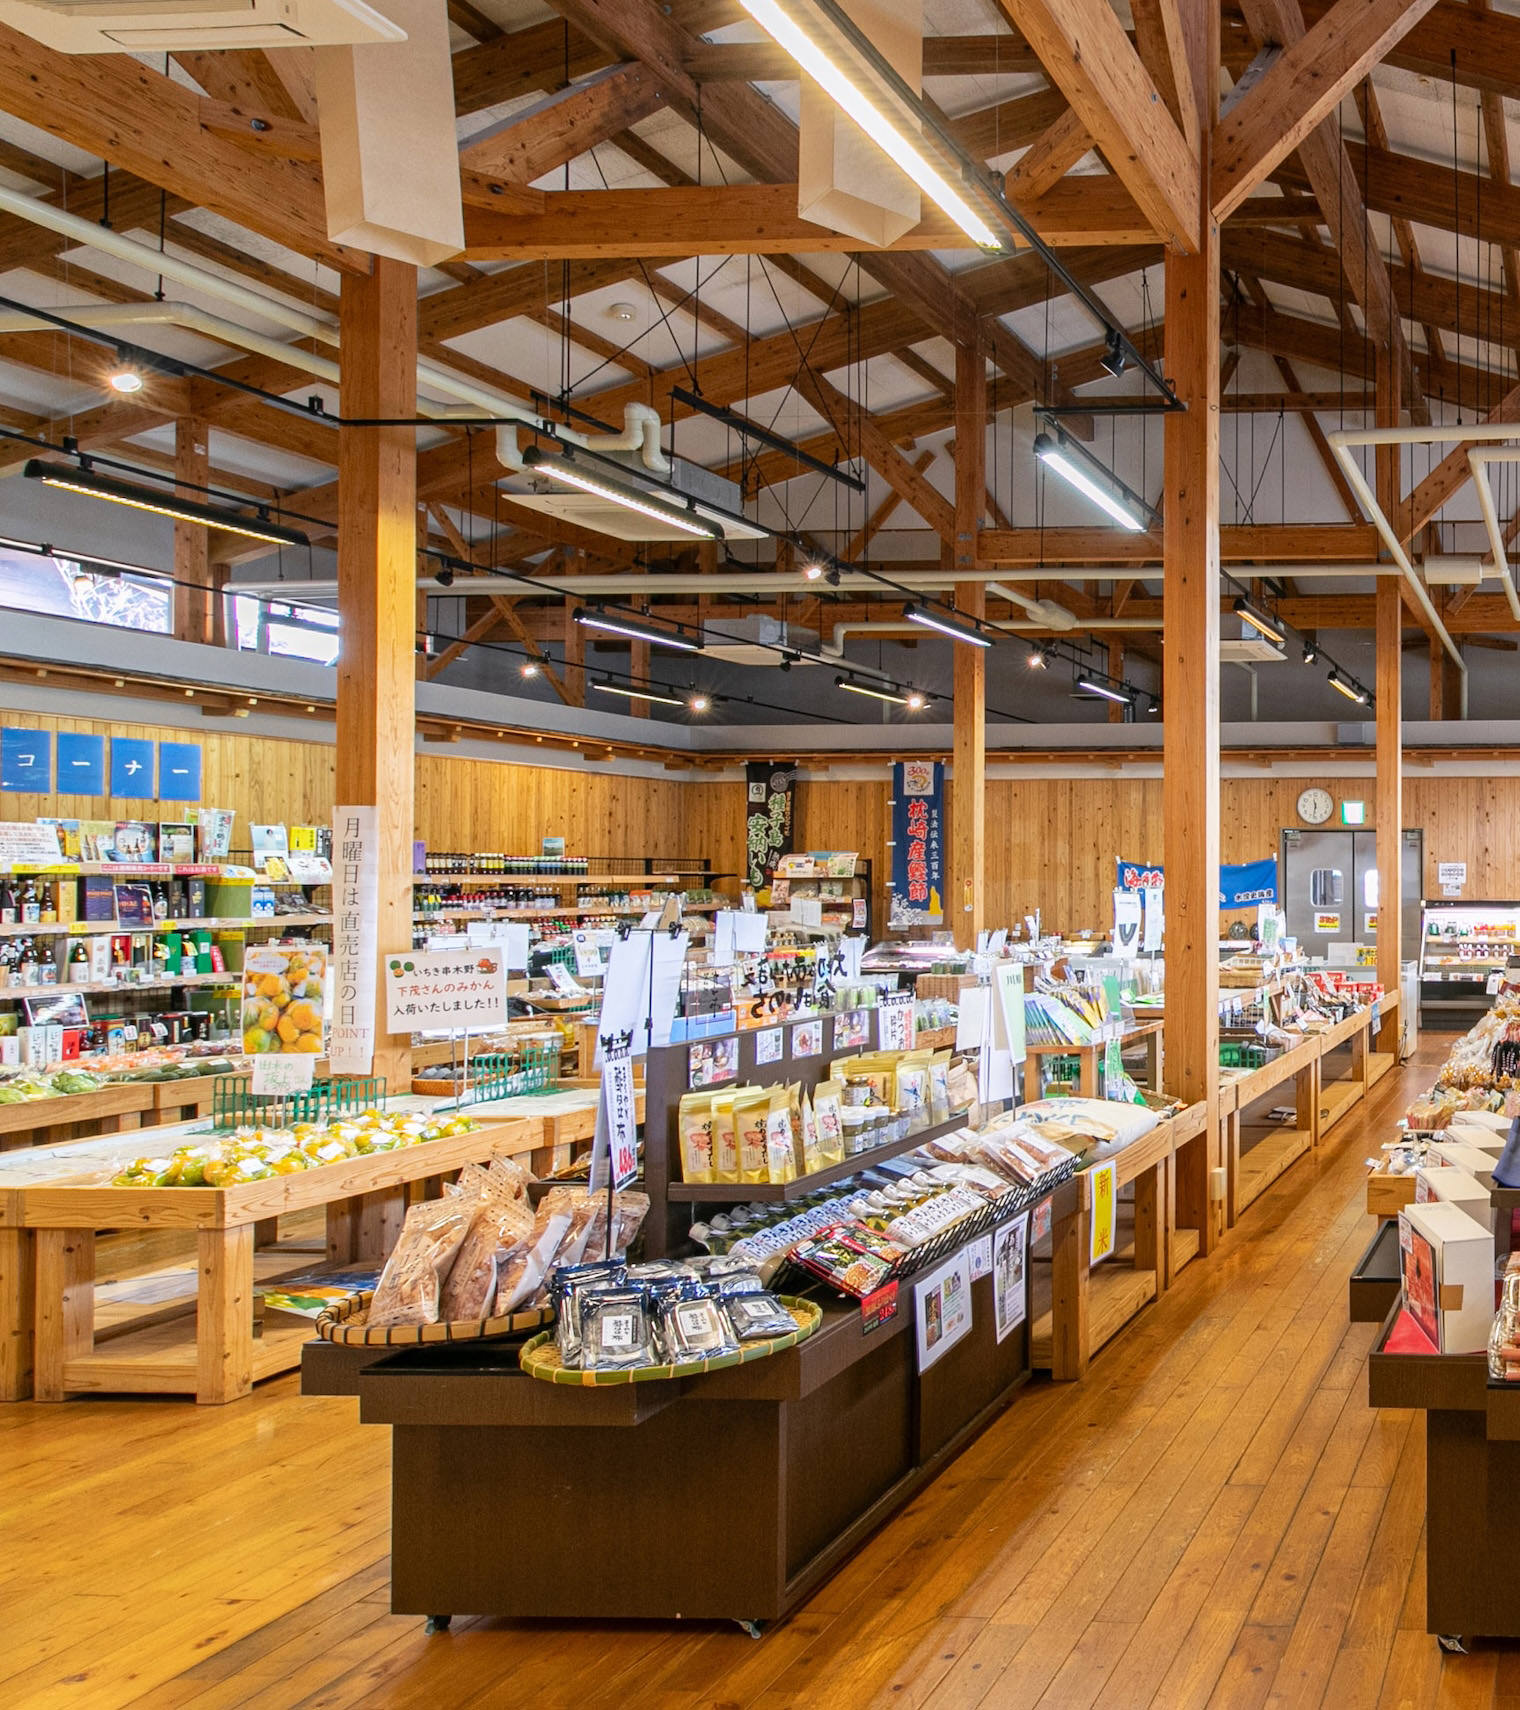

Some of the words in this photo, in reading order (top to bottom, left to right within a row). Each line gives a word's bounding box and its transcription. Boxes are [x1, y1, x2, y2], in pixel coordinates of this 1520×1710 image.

[748, 813, 768, 886] 安納いも
[768, 793, 786, 848] 種子島
[907, 799, 929, 901] 枕崎産鰹節
[339, 817, 363, 1025] 月曜日は直売店の日
[397, 981, 495, 997] 下茂さんのみかん
[413, 964, 475, 978] いちき串木野
